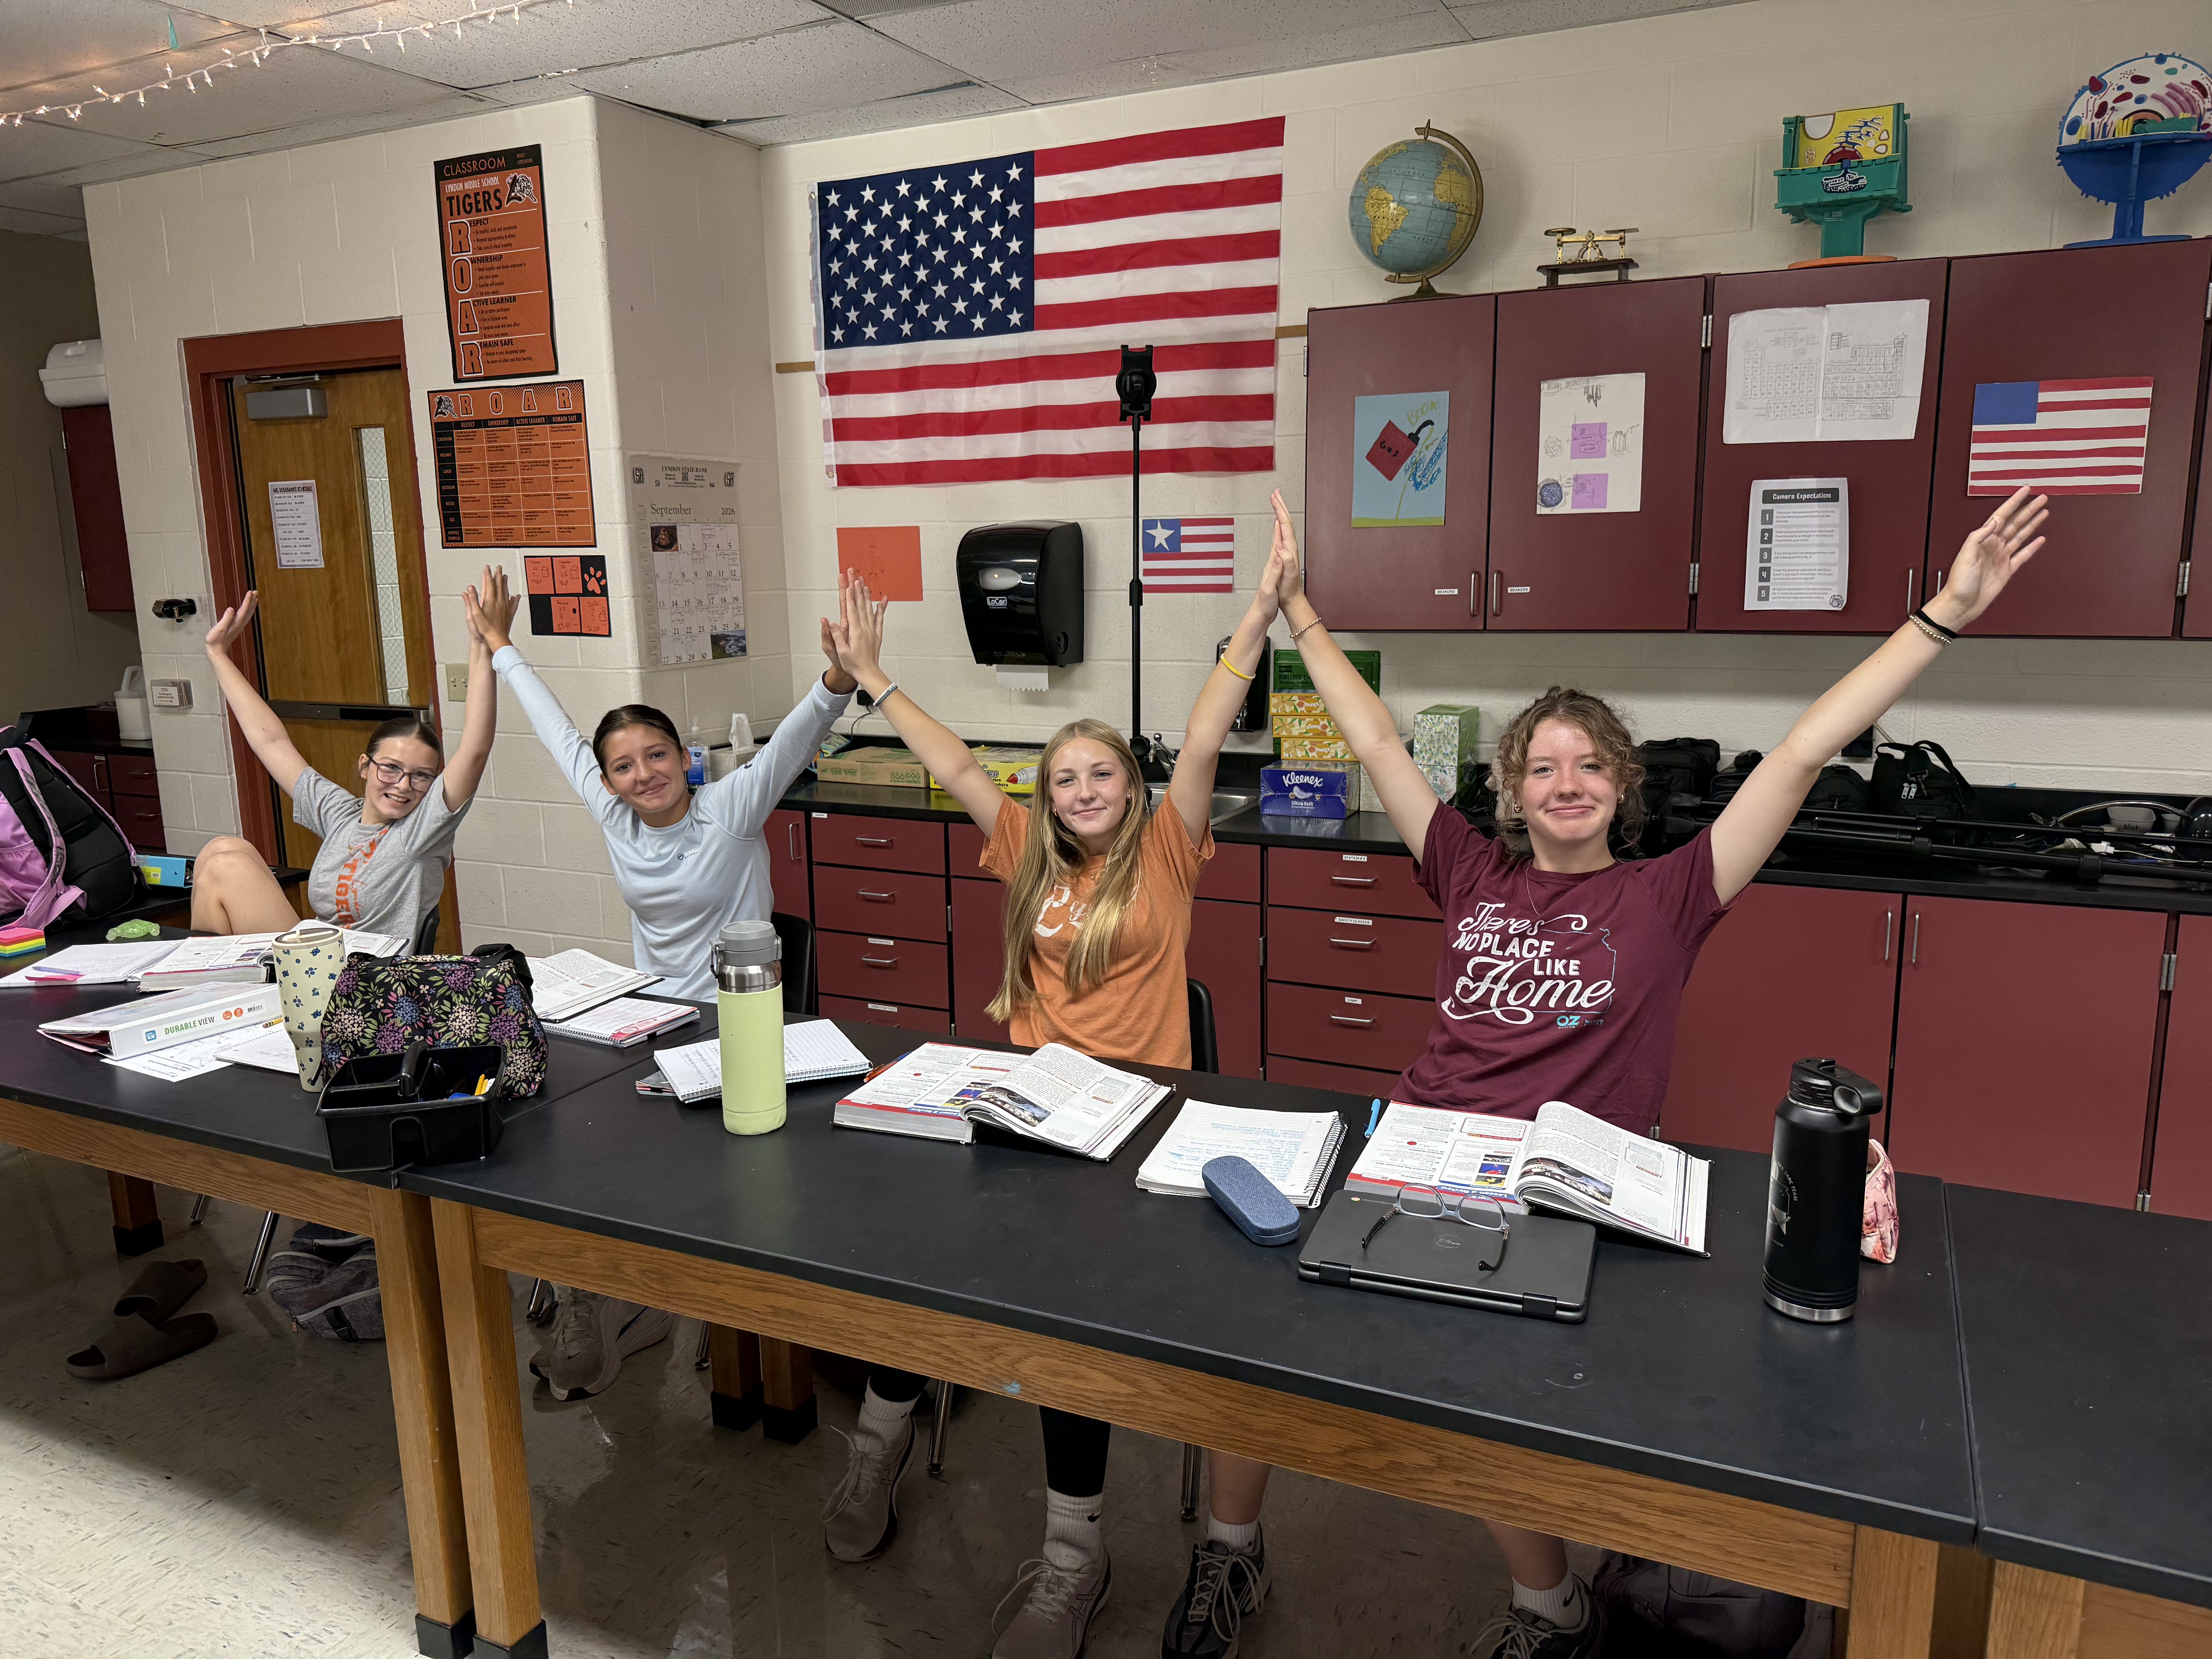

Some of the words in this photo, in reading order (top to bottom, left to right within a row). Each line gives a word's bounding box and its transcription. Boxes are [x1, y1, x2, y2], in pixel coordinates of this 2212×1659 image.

[444, 156, 505, 176] CLASSROOM
[445, 182, 463, 193] LYNDON
[464, 180, 481, 190] MIDDLE
[482, 176, 500, 187] SCHOOL
[446, 189, 502, 216] TIGERS
[490, 296, 516, 305] LEARNER
[459, 393, 473, 416] R
[489, 392, 503, 414] O
[522, 389, 537, 412] A
[556, 387, 572, 410] R
[1406, 397, 1441, 426] BOOM!
[633, 468, 644, 483] LSB
[651, 503, 692, 517] September
[1282, 771, 1323, 788] Kleenex
[1452, 932, 1479, 951] NO
[1478, 933, 1554, 958] PLACE
[1534, 958, 1580, 975] LIKE
[1441, 956, 1615, 1024] Home
[164, 1020, 197, 1035] DURABLE
[198, 1016, 215, 1026] VIEW
[1556, 1015, 1581, 1027] OZ
